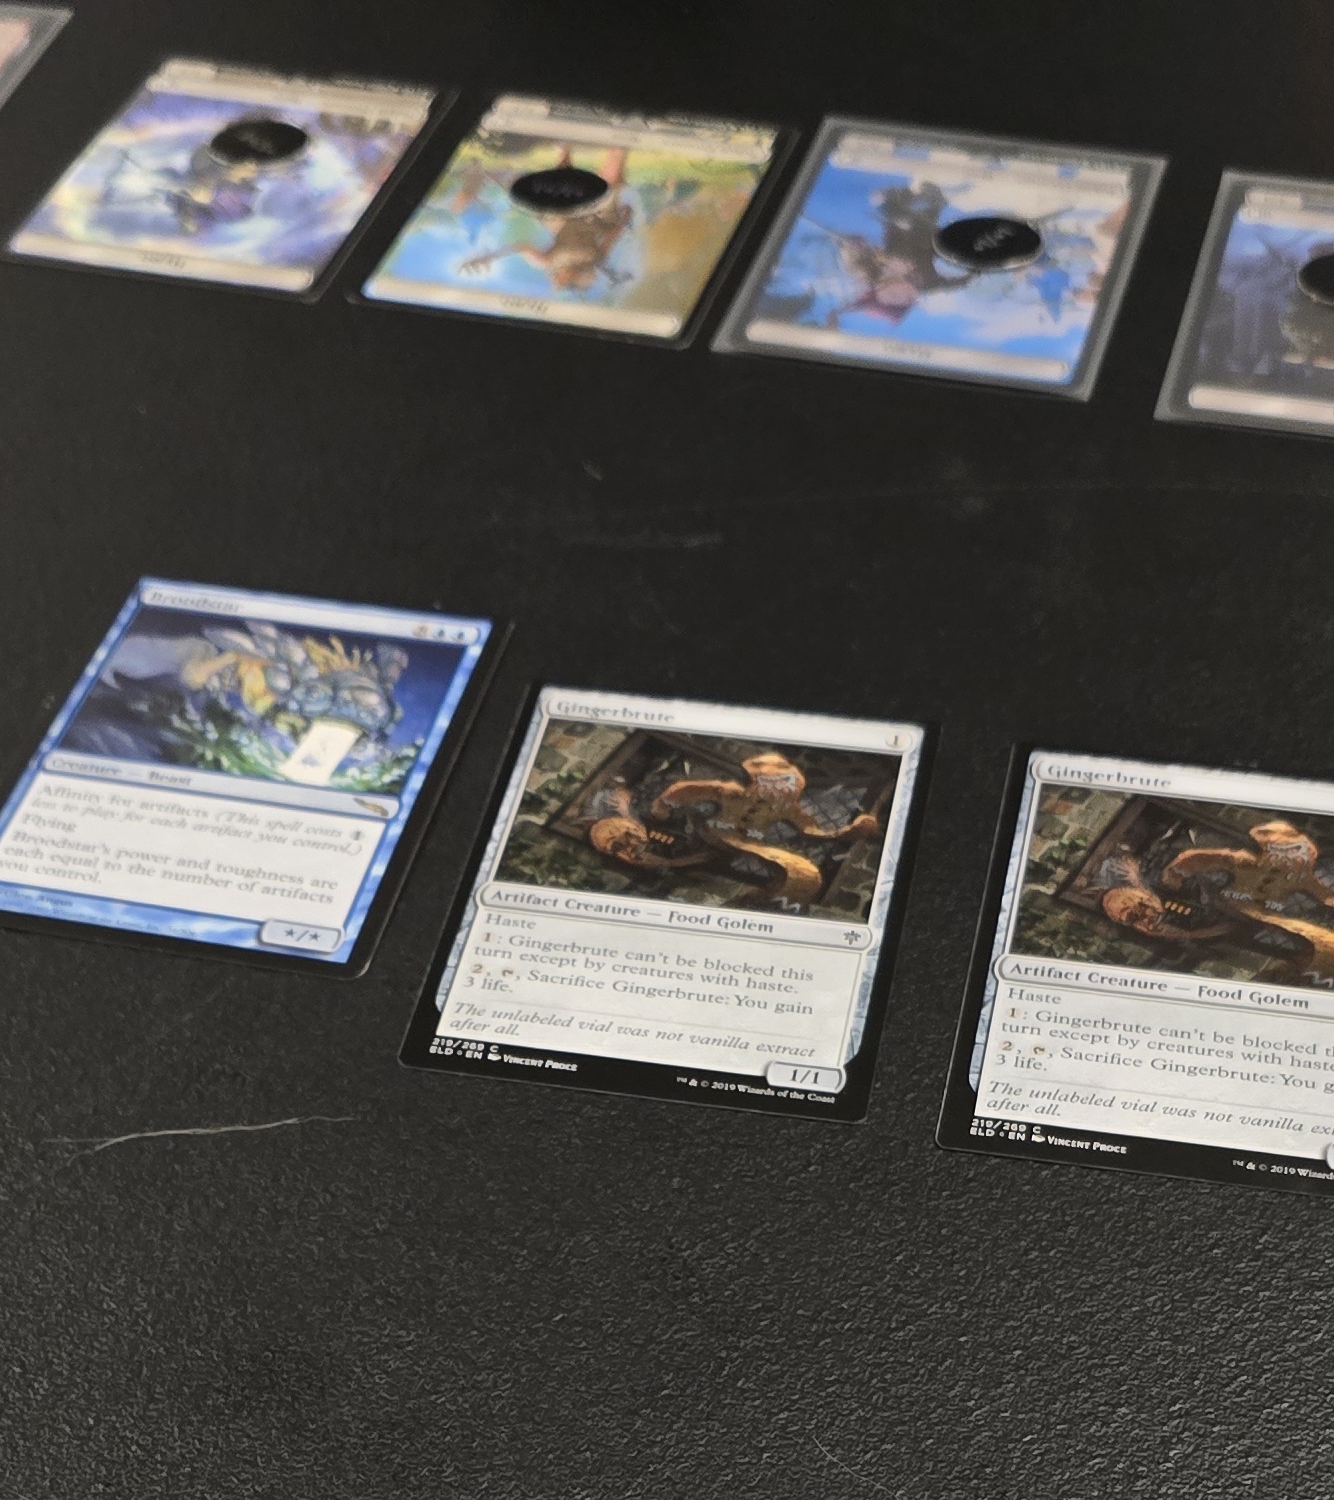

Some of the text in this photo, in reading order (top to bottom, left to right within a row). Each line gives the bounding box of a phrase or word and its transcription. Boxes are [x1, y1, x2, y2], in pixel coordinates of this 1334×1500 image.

[554, 701, 676, 724] Gingerbrute
[1046, 764, 1172, 789] Gingerbrute
[490, 890, 774, 933] Artifact Creature Food Golem
[484, 914, 537, 930] Haste
[1007, 988, 1062, 1004] Haste
[1009, 963, 1309, 1009] Artifact Creature Food Golem
[448, 1016, 522, 1036] after all.
[995, 1055, 1048, 1071] 3 life.
[789, 1068, 819, 1085] 1/1
[986, 1097, 1063, 1116] after all.
[989, 1081, 1023, 1096] The
[1029, 1087, 1114, 1108] unlabeled
[1120, 1098, 1156, 1113] vial
[1162, 1106, 1196, 1118] was
[1204, 1110, 1231, 1123] not
[1238, 1113, 1303, 1132] vanilla
